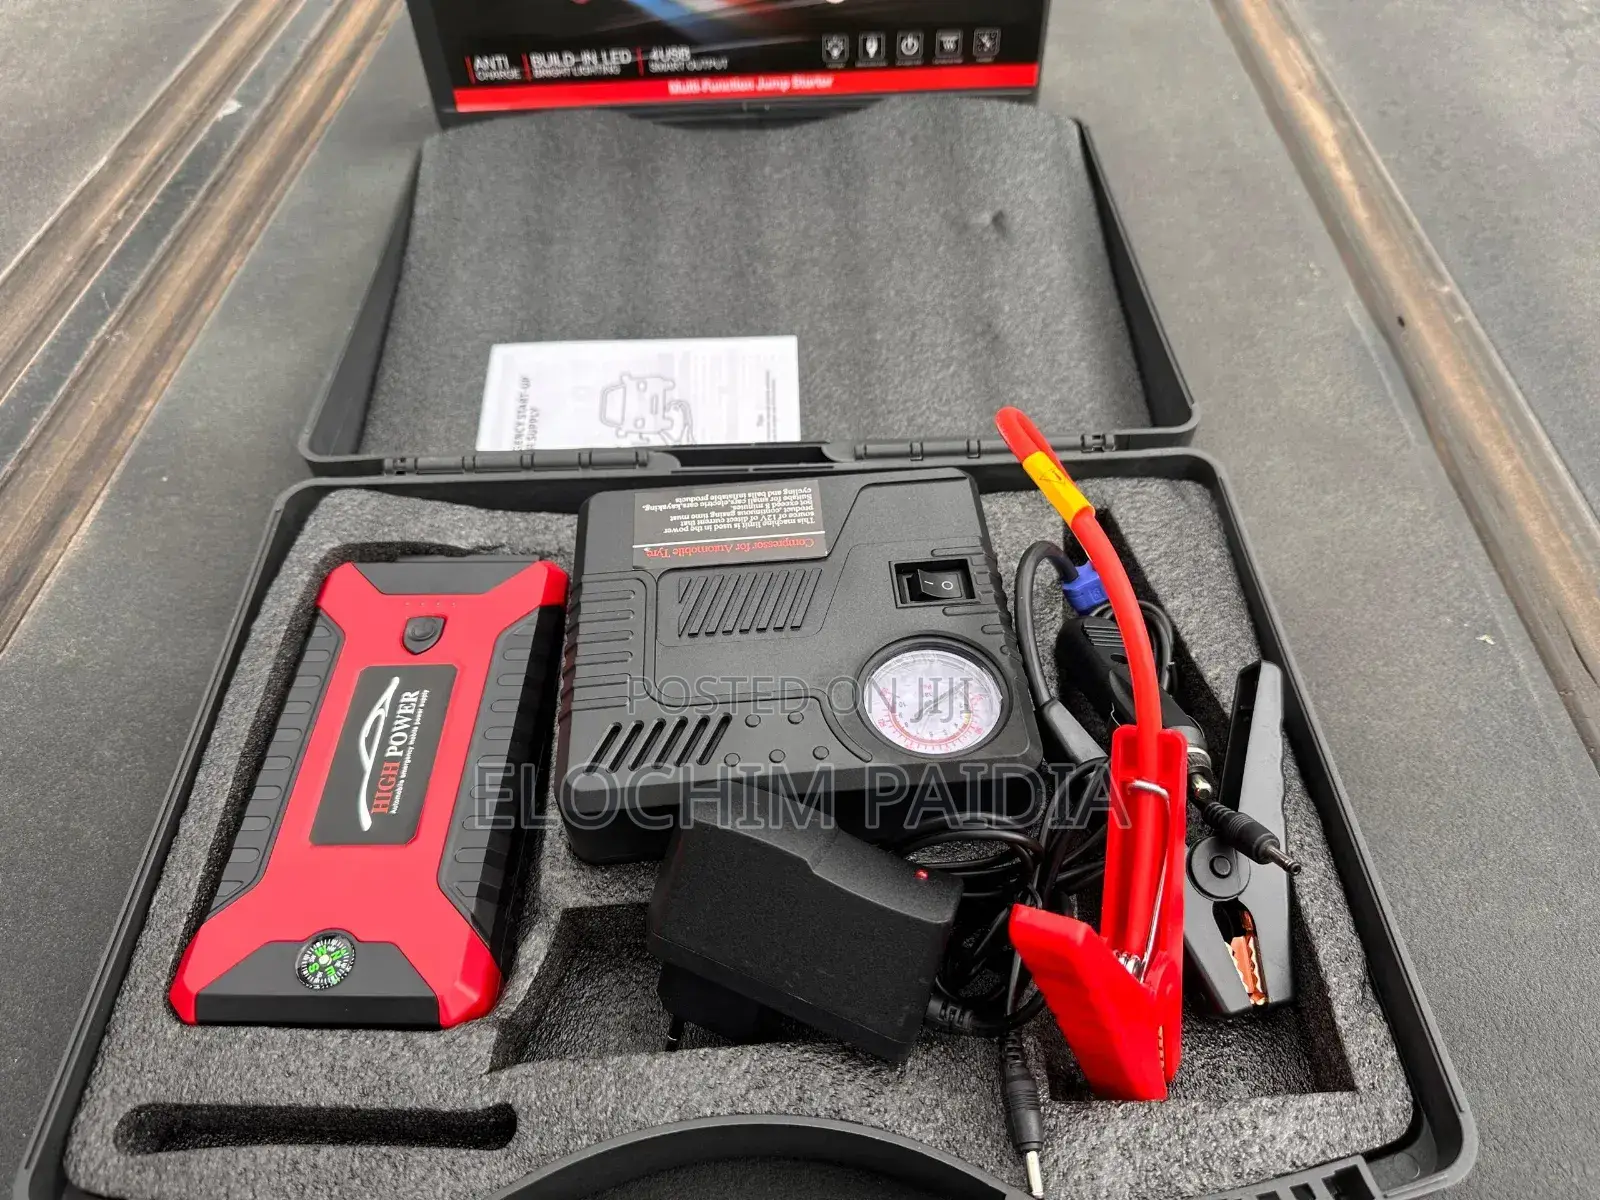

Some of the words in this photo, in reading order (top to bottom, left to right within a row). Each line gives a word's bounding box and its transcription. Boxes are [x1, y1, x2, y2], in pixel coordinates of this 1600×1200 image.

[601, 48, 632, 65] LED
[474, 55, 508, 71] ANTI
[675, 494, 709, 503] products
[748, 498, 768, 506] small
[742, 521, 761, 529] limit
[762, 519, 796, 527] machine
[736, 543, 750, 552] for
[752, 538, 814, 548] Compressor
[673, 544, 732, 556] Automobile
[420, 689, 431, 707] supply
[414, 706, 424, 726] power
[384, 690, 419, 757] POWER
[407, 725, 419, 745] mobile
[401, 746, 414, 779] emergency
[371, 761, 401, 814] HIGH
[389, 779, 405, 814] Automobile
[331, 948, 347, 960] N
[308, 962, 319, 973] S
[325, 966, 336, 976] E
